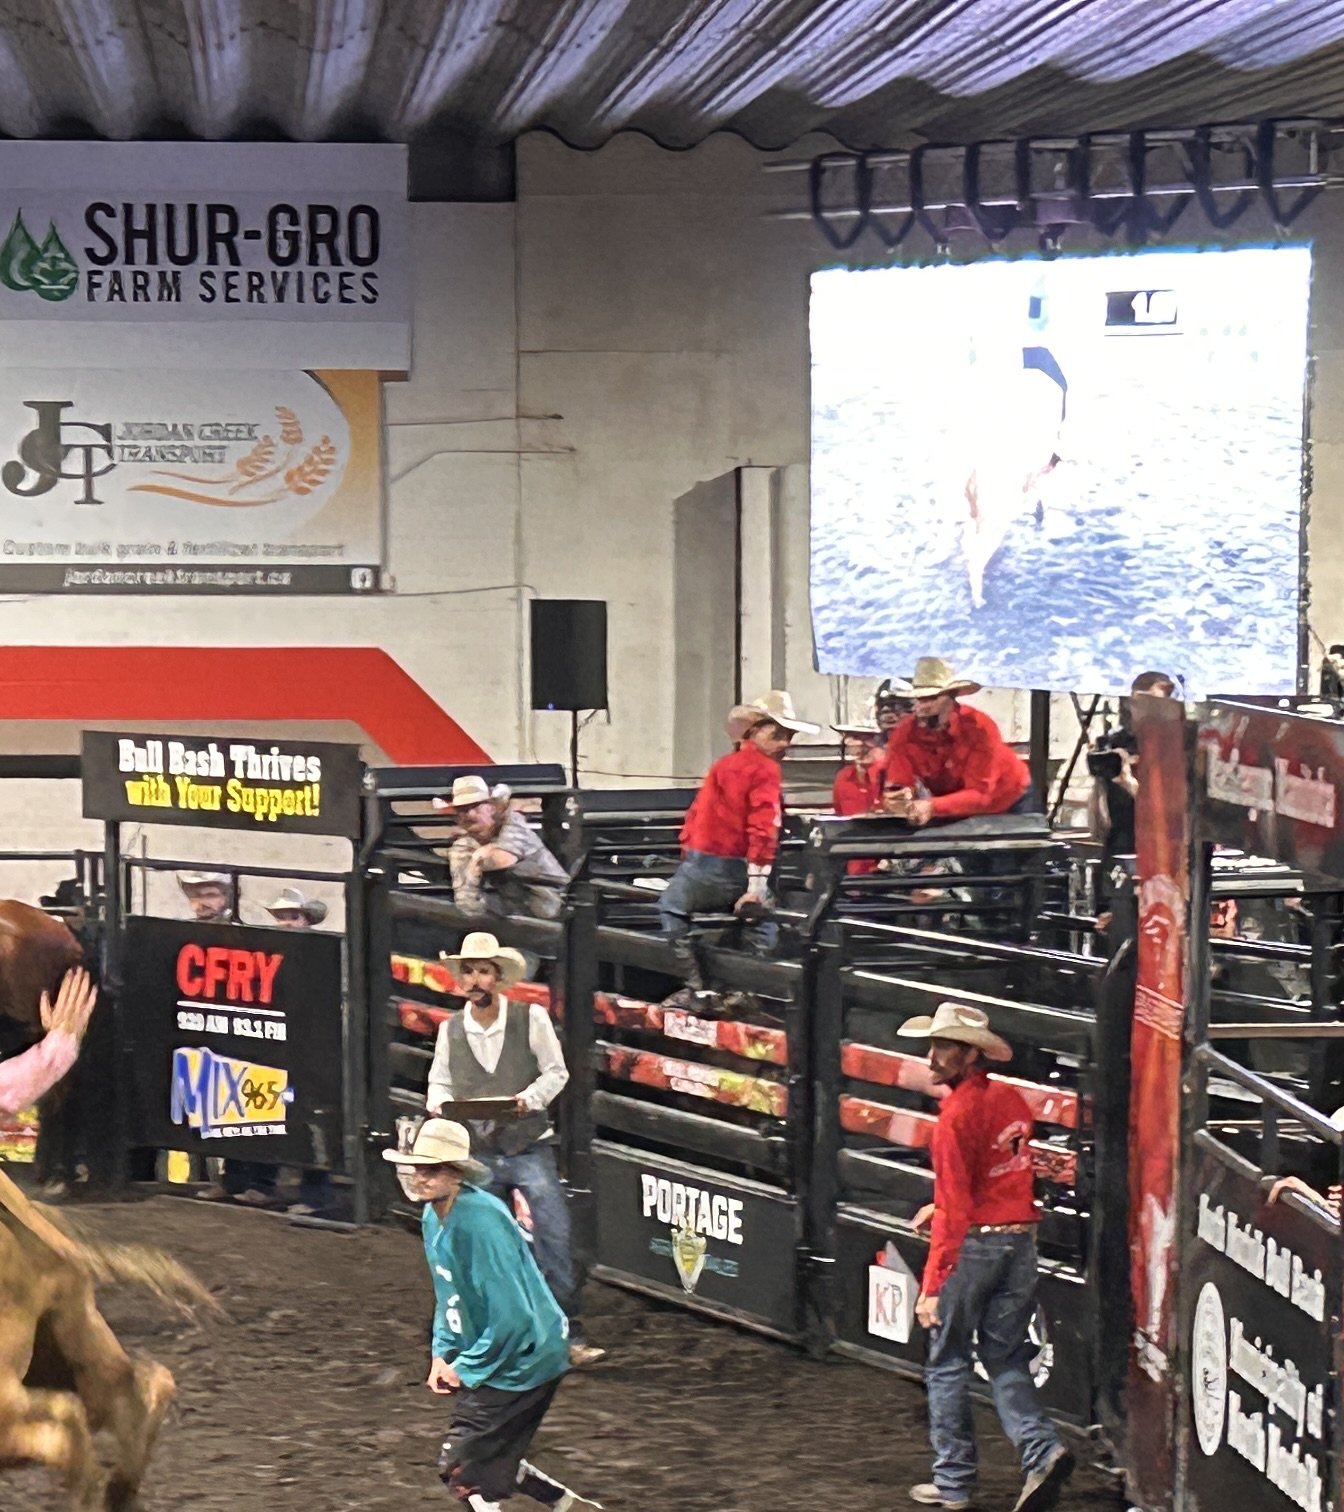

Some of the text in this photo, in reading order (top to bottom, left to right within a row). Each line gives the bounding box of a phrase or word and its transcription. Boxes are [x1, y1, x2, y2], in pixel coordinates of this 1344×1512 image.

[84, 202, 381, 267] SHUR-GRO
[86, 271, 380, 305] FARM SERVICES
[117, 738, 322, 783] Bull Bash Thrives
[125, 773, 321, 823] with Your Support!
[176, 943, 285, 1005] CFRY
[171, 1046, 248, 1140] MIX
[640, 1173, 745, 1246] PORTAGE
